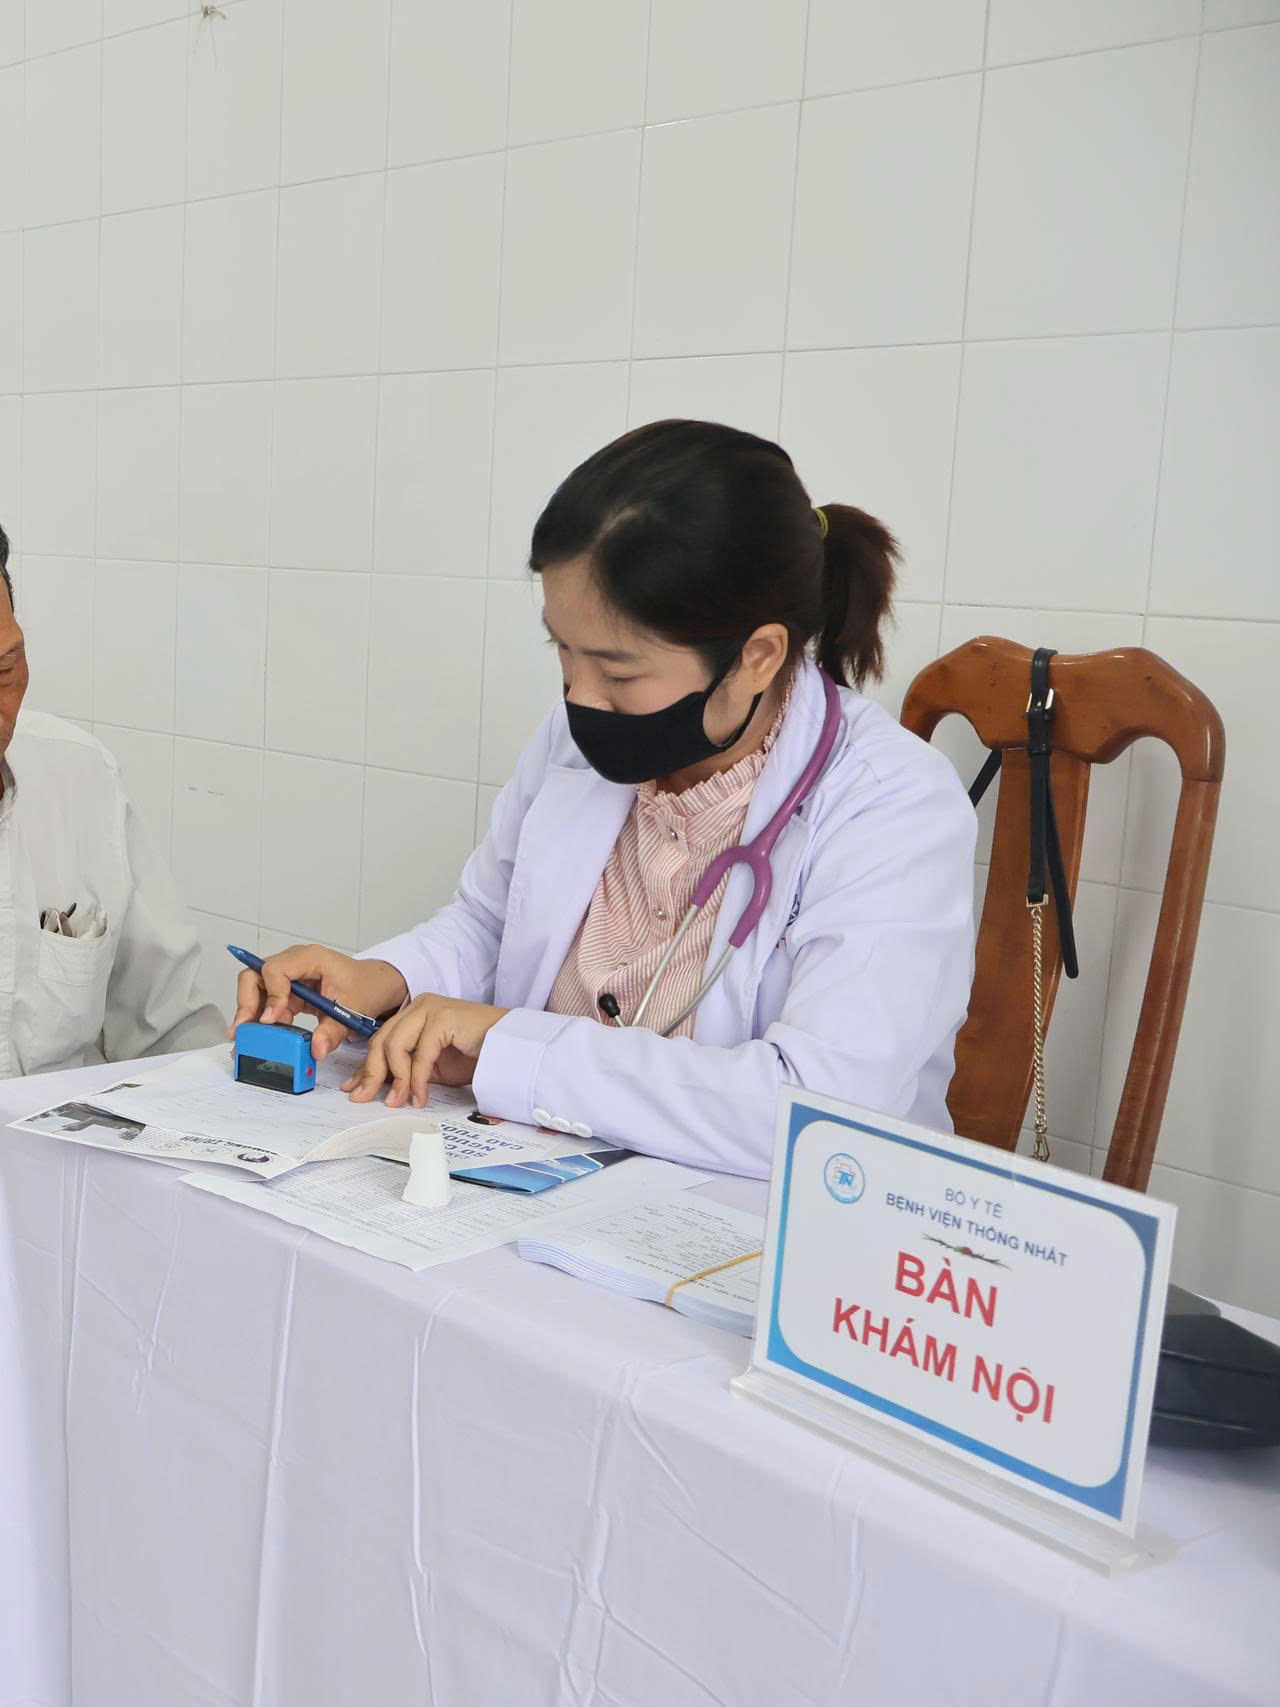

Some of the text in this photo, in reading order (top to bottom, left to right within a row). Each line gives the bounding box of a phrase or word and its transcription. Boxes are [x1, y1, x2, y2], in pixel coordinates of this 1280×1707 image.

[886, 1193, 925, 1217] BỆNH
[929, 1207, 962, 1229] VIỆN
[971, 1196, 980, 1209] Y
[895, 1251, 998, 1328] BÀN
[832, 1296, 1055, 1424] KHÁM NỘI
